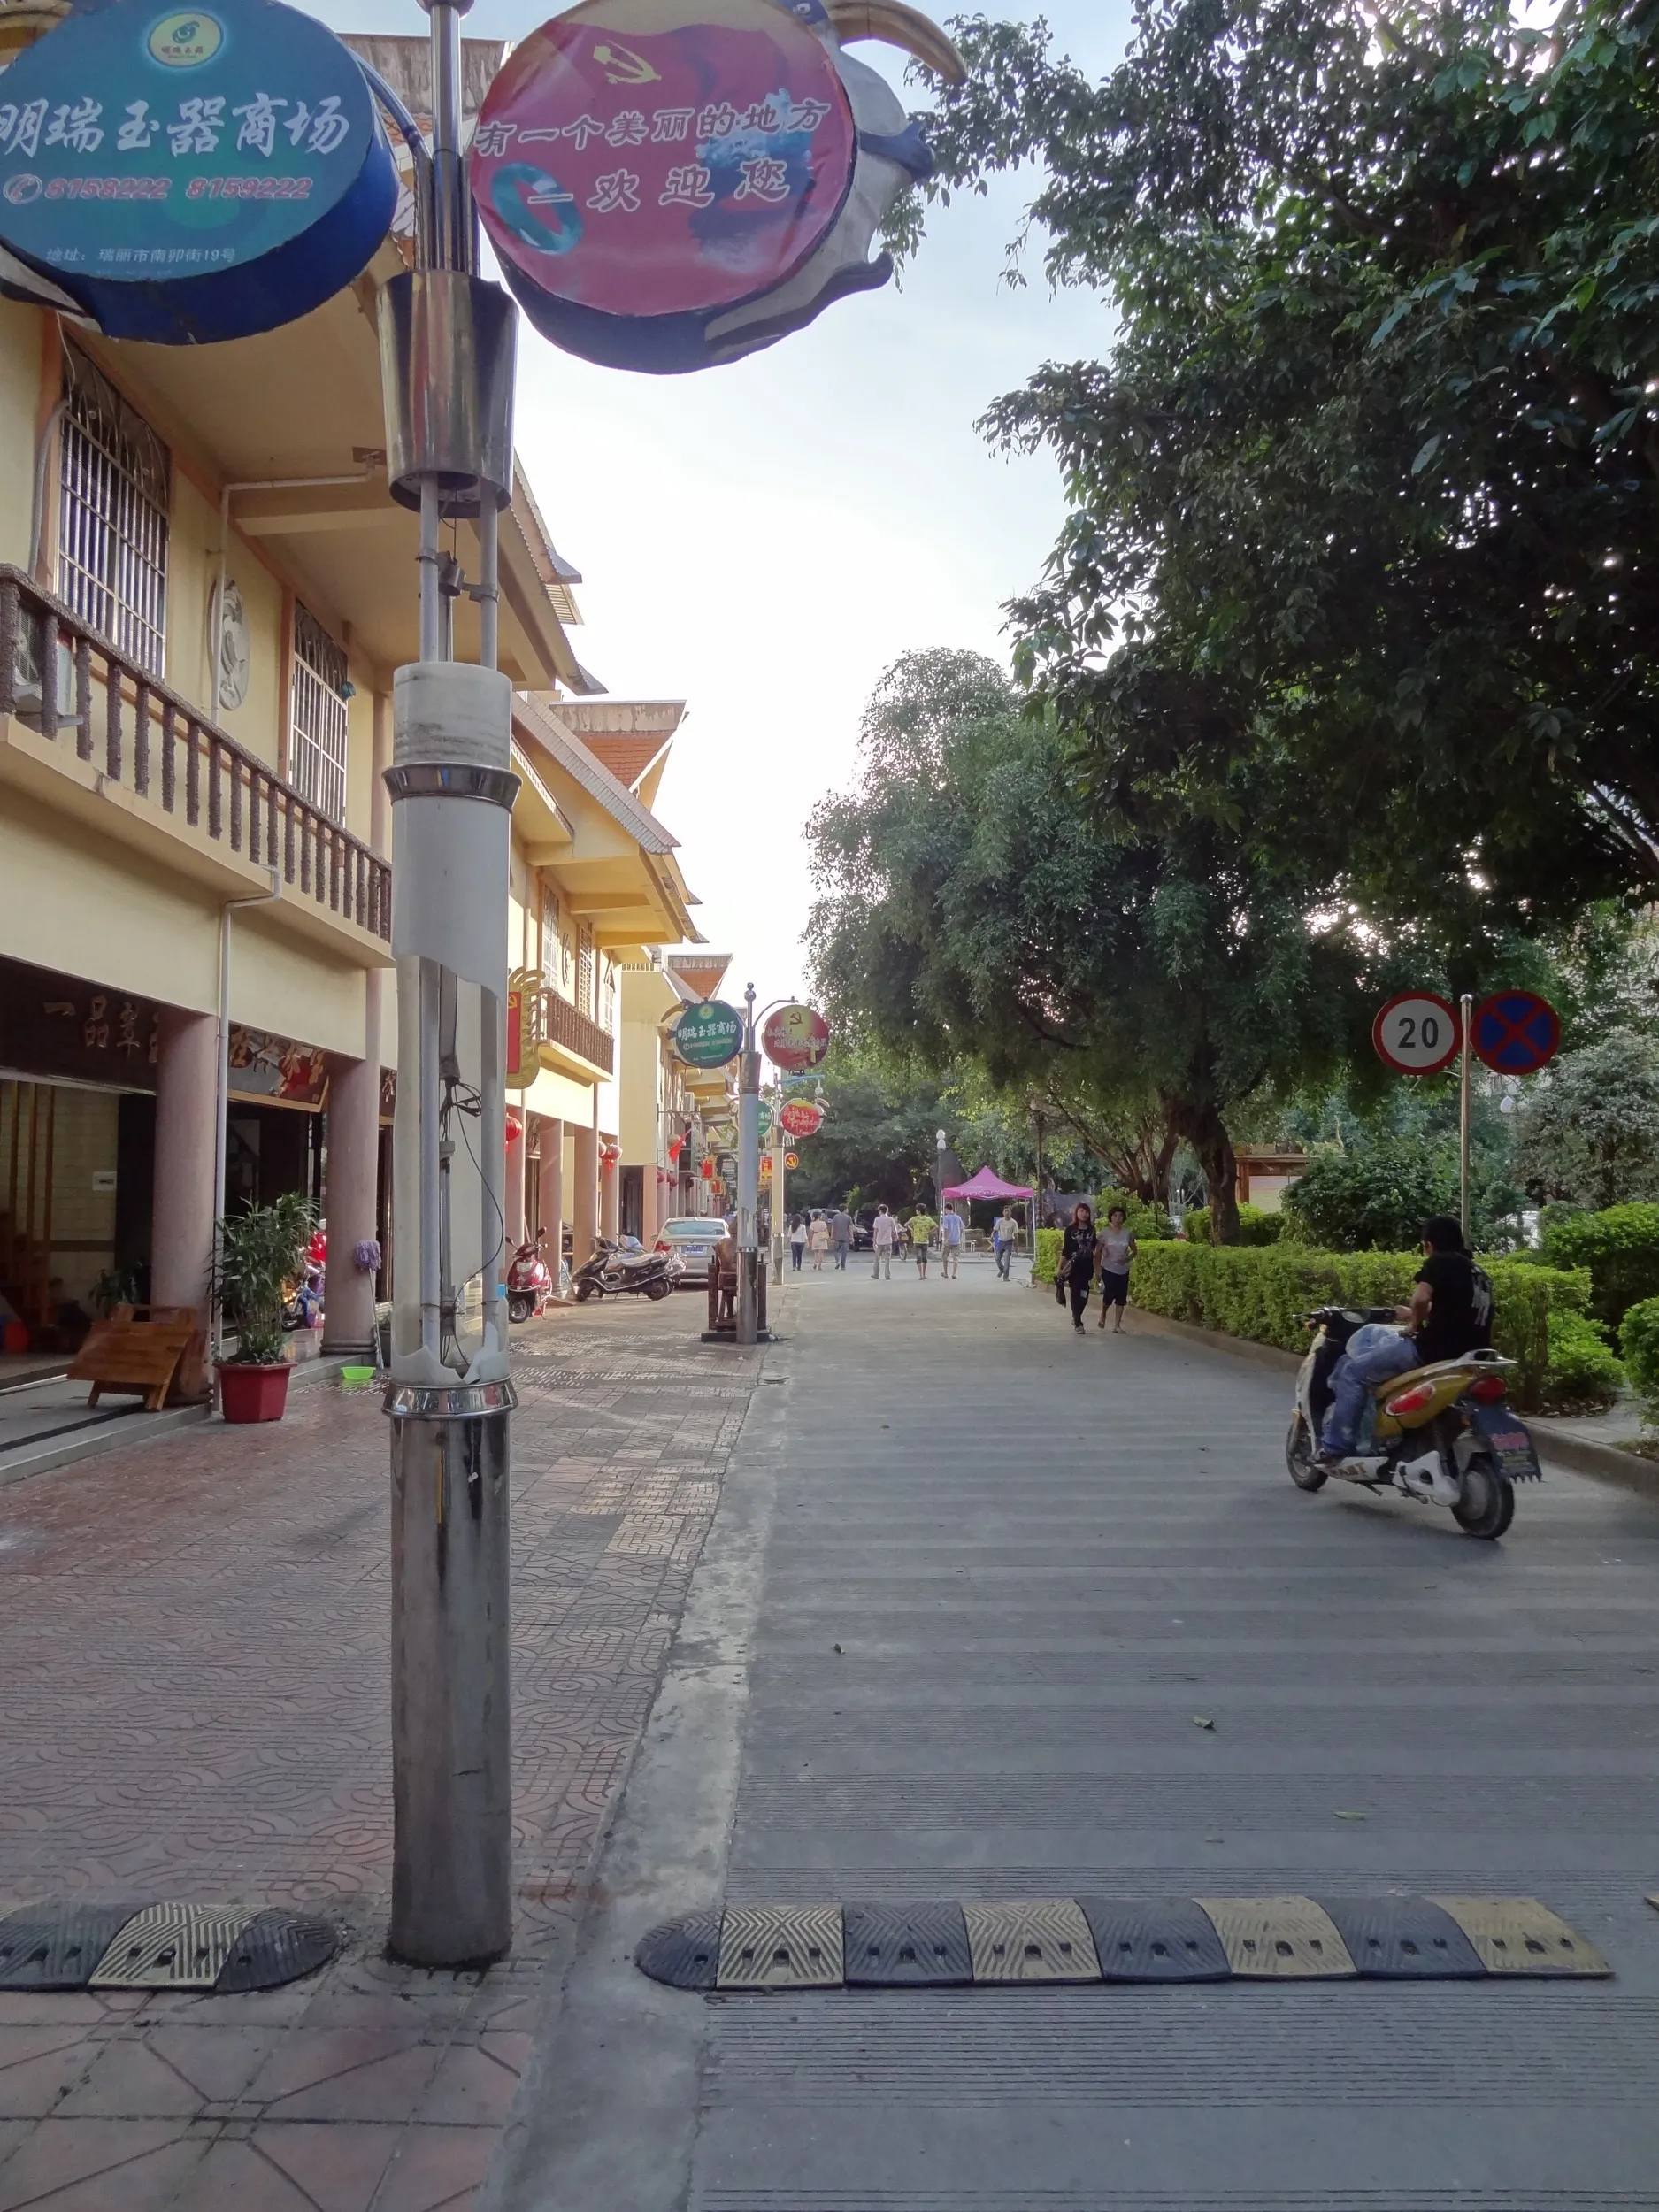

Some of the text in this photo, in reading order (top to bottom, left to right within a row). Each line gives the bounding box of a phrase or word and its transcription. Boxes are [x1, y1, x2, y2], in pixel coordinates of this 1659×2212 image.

[0, 92, 350, 158] 明瑞玉器商场
[474, 98, 832, 157] 有一个美丽的地方
[44, 177, 313, 200] 8158222 8159222
[677, 1020, 736, 1041] 明瑞玉器商场
[1398, 1017, 1439, 1048] 20
